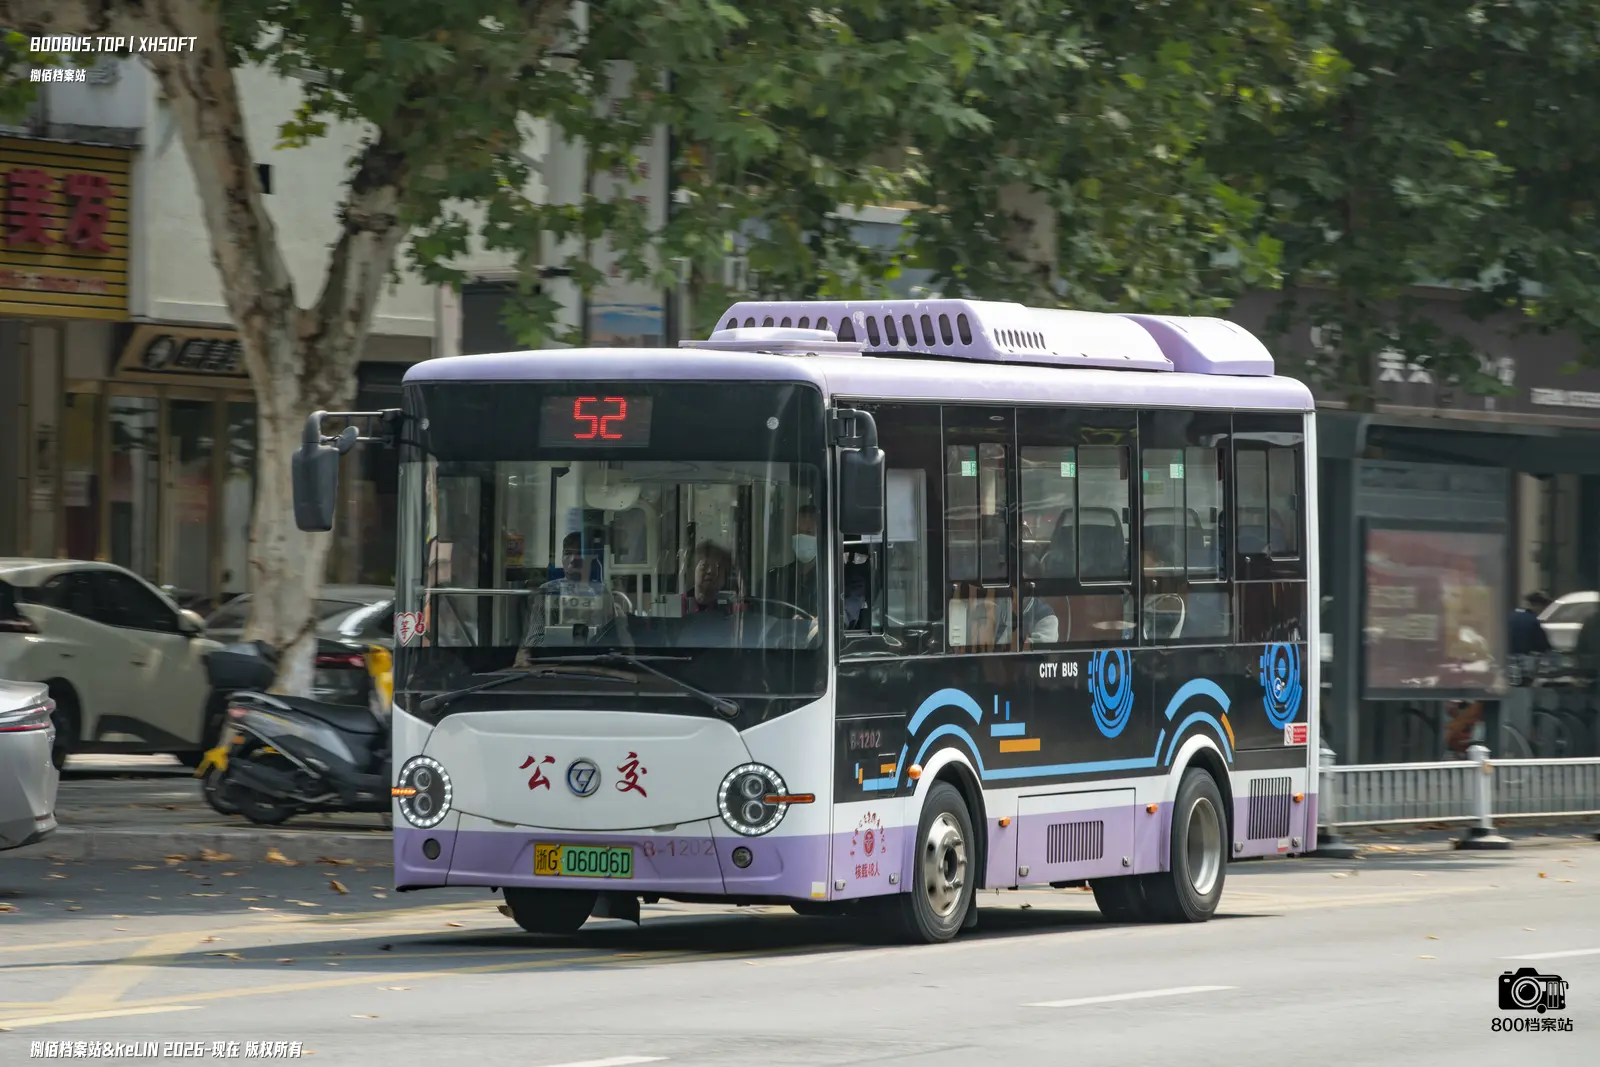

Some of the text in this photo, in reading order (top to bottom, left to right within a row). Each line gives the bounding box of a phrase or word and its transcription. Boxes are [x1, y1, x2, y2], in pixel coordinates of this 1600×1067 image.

[574, 397, 627, 438] 52
[1039, 661, 1078, 678] CITY BUS
[519, 751, 648, 798] 公 交
